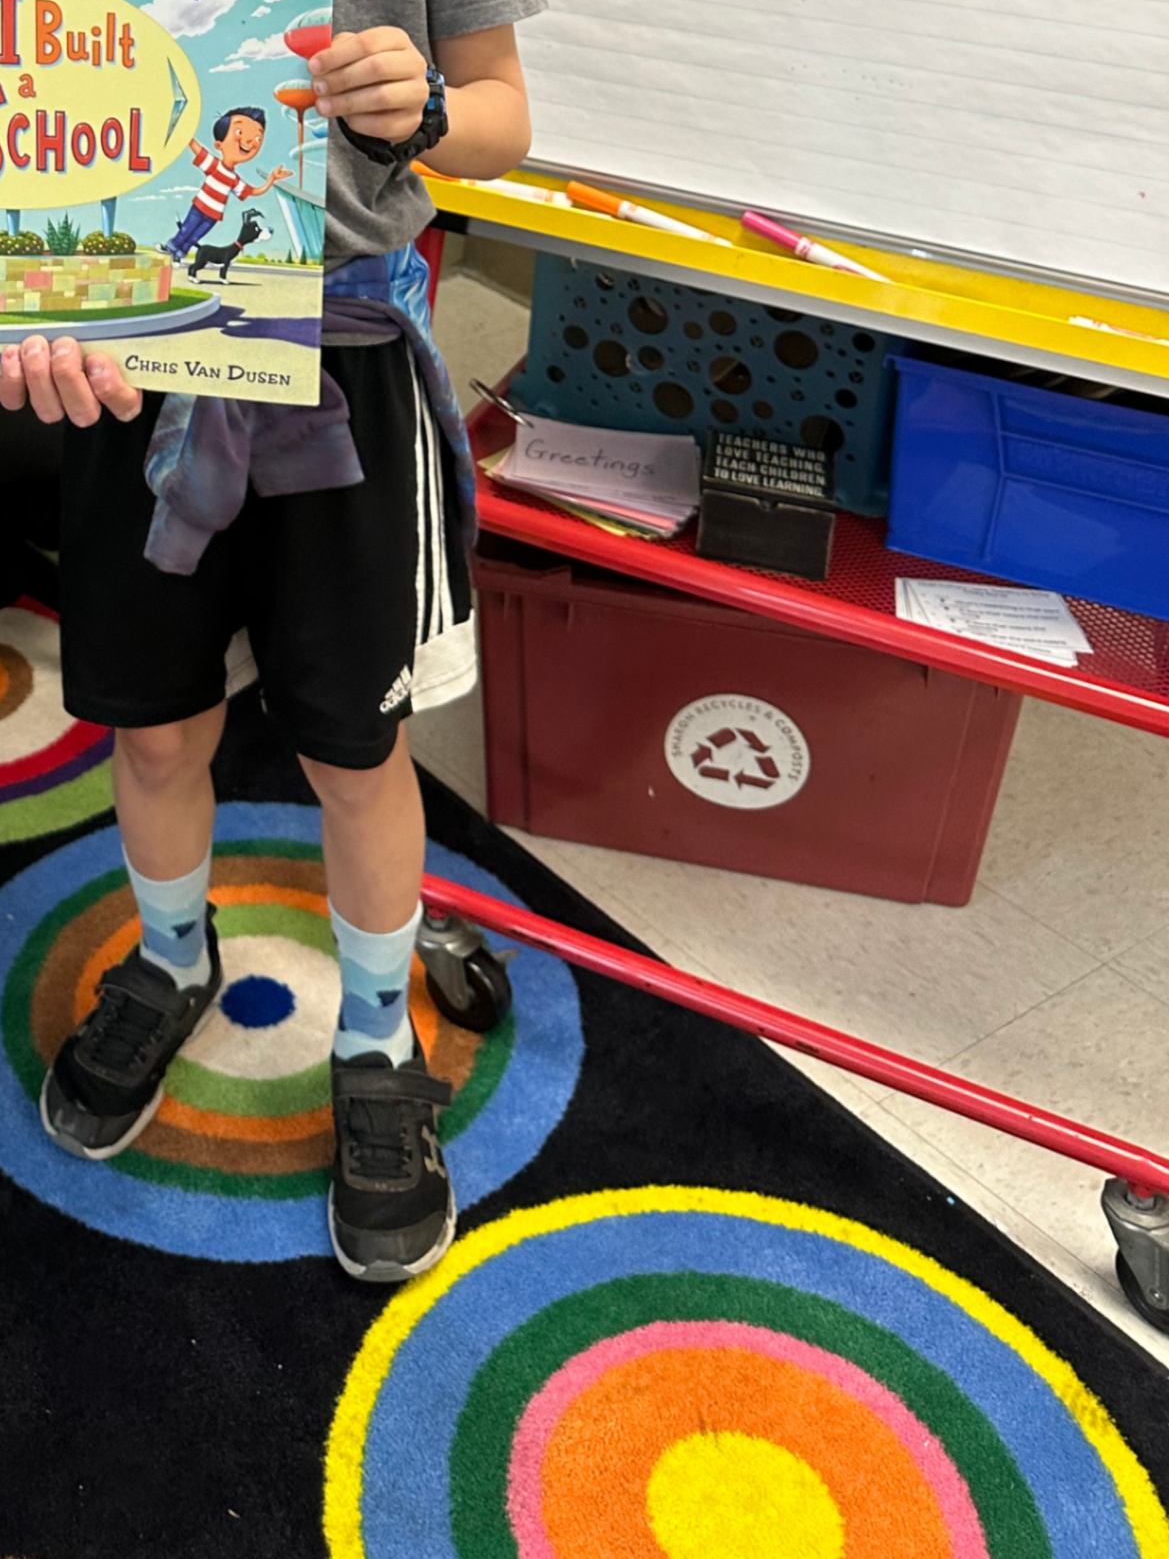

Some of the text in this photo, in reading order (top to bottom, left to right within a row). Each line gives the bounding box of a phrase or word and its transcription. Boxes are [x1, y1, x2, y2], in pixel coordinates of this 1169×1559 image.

[18, 72, 37, 98] a
[124, 353, 179, 378] CHRIS
[227, 363, 292, 387] DUSEN
[716, 444, 750, 460] LOVE
[718, 433, 788, 455] TEACHERS
[525, 438, 657, 479] Greetings
[716, 456, 826, 486] TEACH CHILDREN
[714, 467, 730, 479] TO
[731, 470, 761, 486] LOVE
